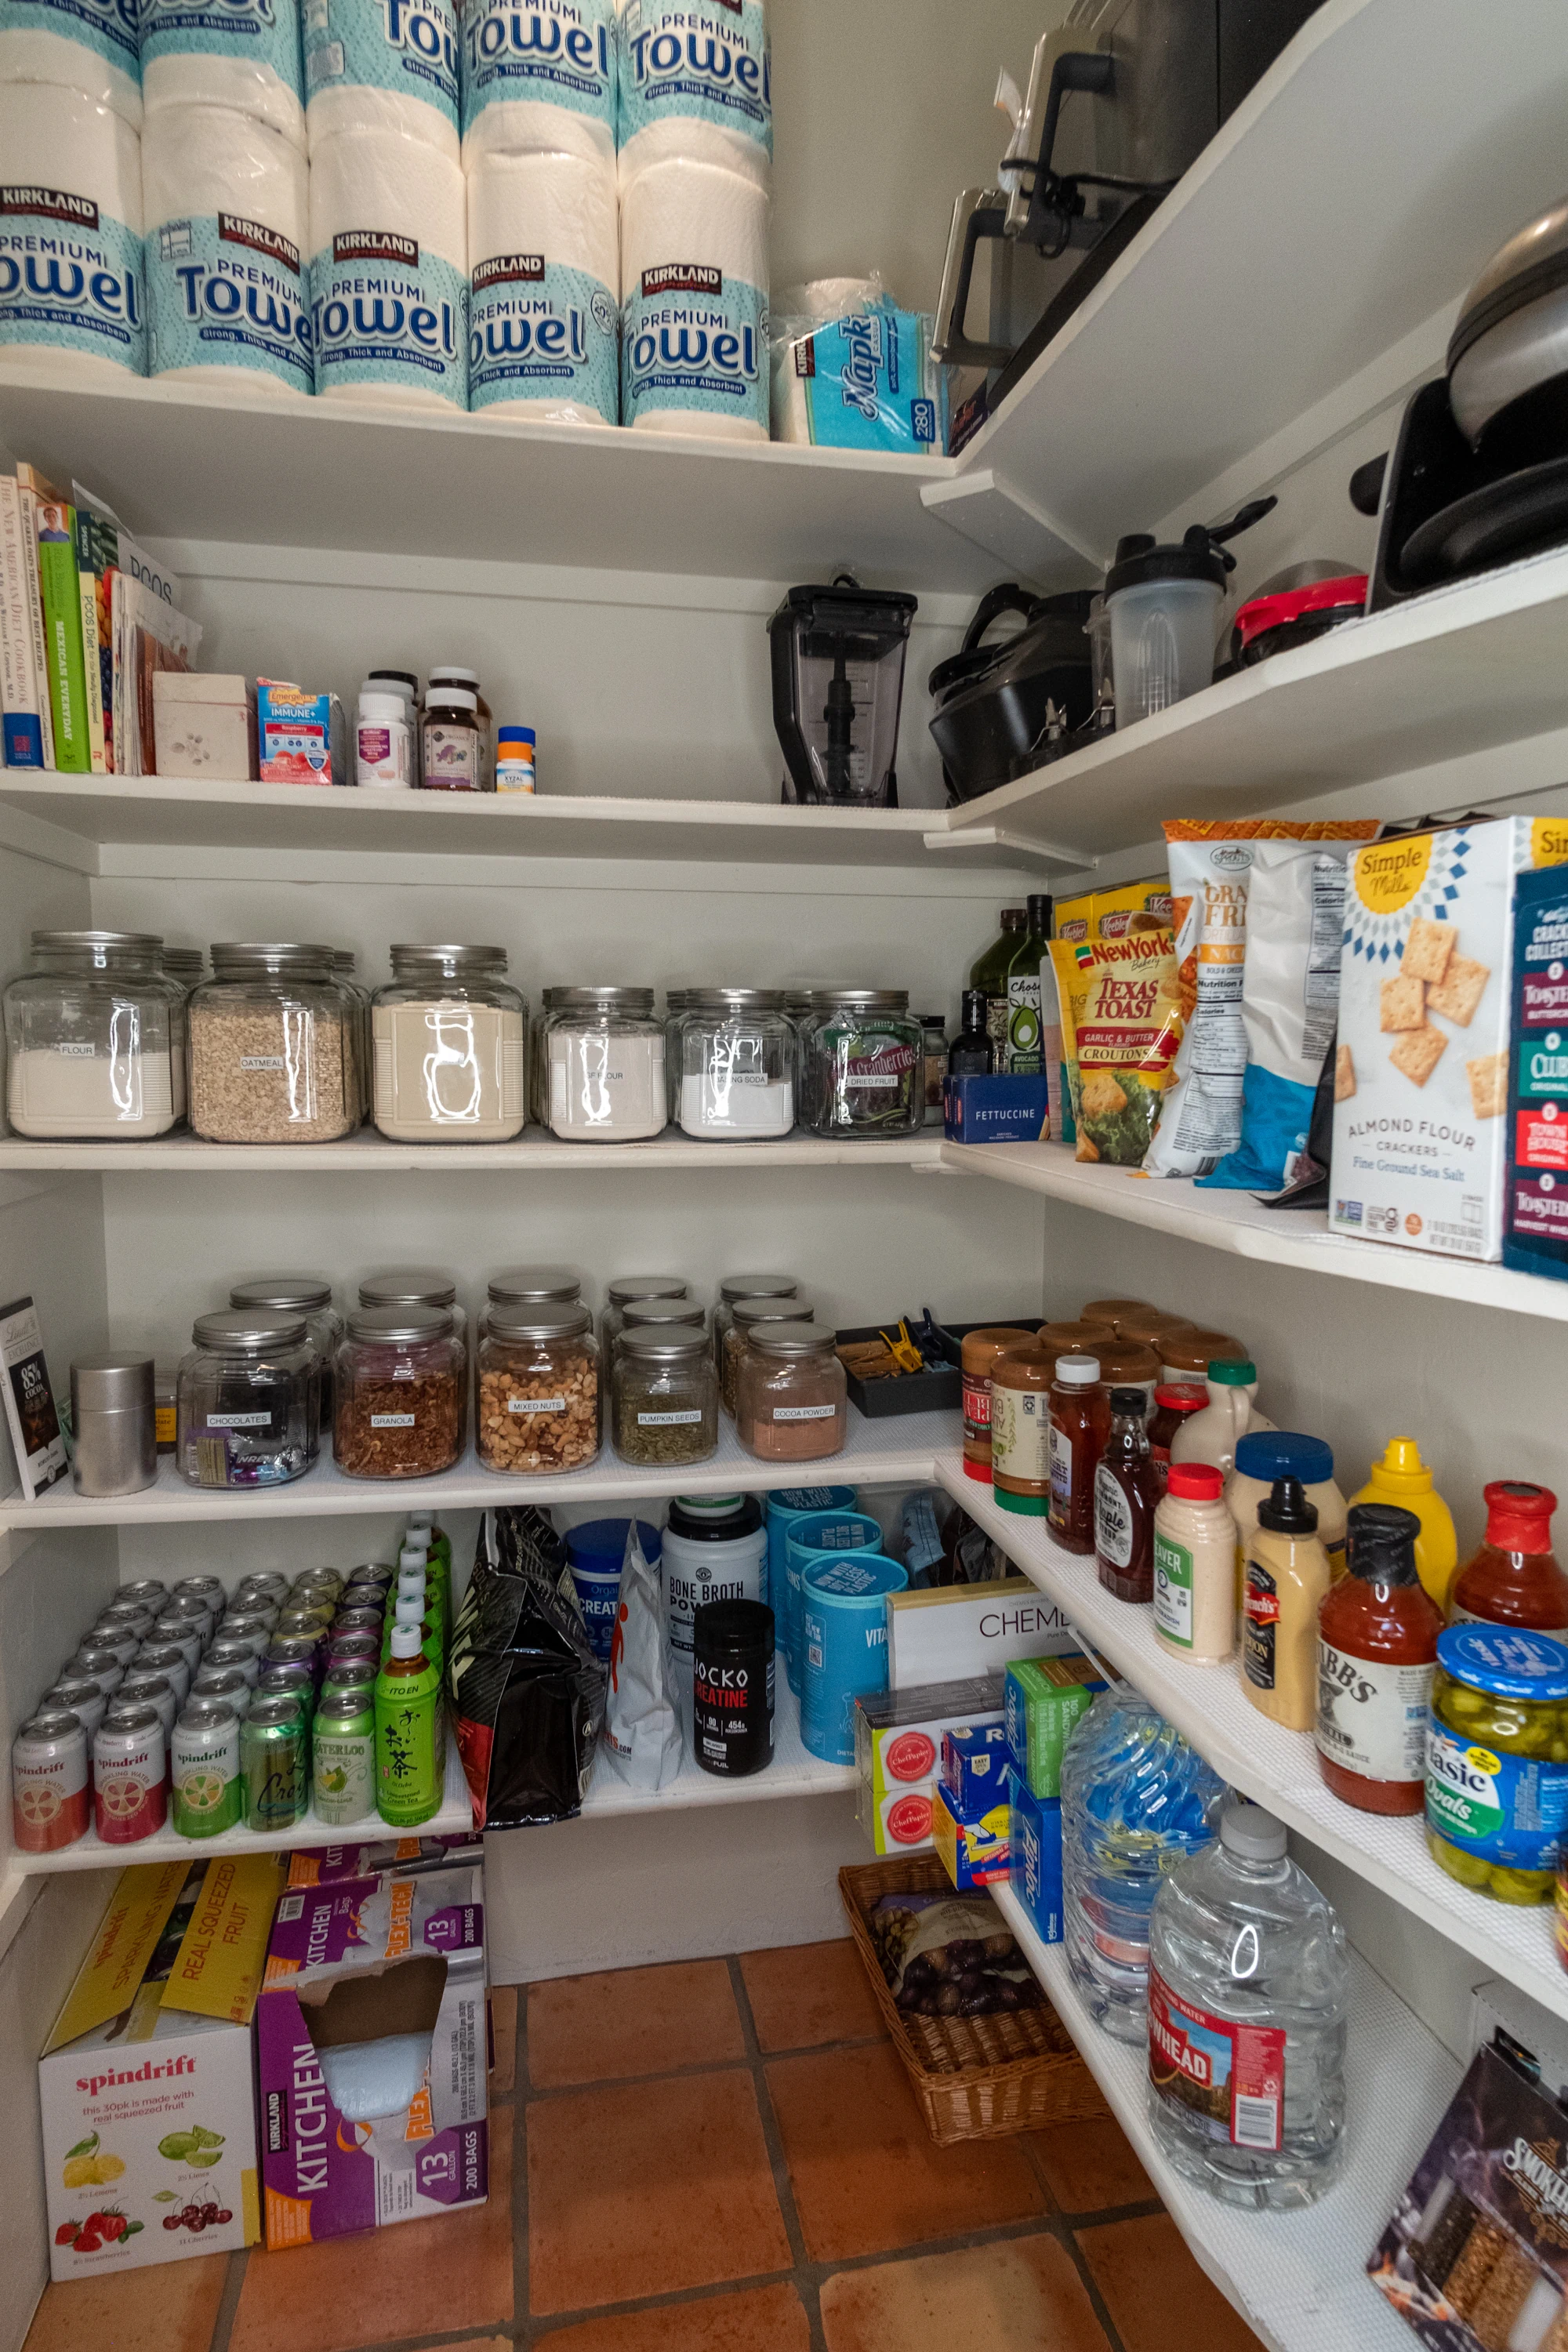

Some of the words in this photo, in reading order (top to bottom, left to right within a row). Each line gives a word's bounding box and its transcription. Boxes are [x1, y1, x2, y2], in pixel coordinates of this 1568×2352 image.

[204, 14, 257, 32] Absorbent
[662, 15, 745, 47] PREMIUM
[504, 66, 529, 76] Thick
[532, 66, 550, 78] and
[553, 71, 599, 94] Absorbent
[631, 31, 771, 107] Towel
[681, 85, 704, 95] Thick
[707, 88, 723, 102] and
[724, 96, 764, 121] Absorbent
[3, 188, 95, 218] KIRKLAND
[223, 216, 298, 262] KIRKLAND
[336, 233, 416, 255] KIRKLAND
[473, 256, 542, 284] KIRKLAND
[644, 265, 719, 286] KIRKLAND
[217, 259, 301, 308] PREMIUM
[332, 278, 420, 301] PREMIUM
[21, 307, 48, 318] Thick
[52, 311, 72, 321] and
[76, 316, 128, 341] Absorbent
[311, 296, 455, 356] Towel
[641, 309, 723, 330] PREMIUM
[241, 332, 267, 348] Thick
[270, 345, 287, 358] and
[348, 347, 372, 358] Thick
[397, 348, 442, 372] Absorbent
[483, 369, 501, 380] Thick
[504, 365, 521, 376] and
[523, 366, 571, 376] Absorbent
[653, 376, 676, 386] Thick
[680, 376, 696, 385] and
[699, 376, 743, 393] Absorbent
[914, 403, 929, 437] 280
[6, 539, 20, 602] AMERICAN
[129, 554, 172, 606] PCOS
[11, 604, 24, 634] DIET
[84, 595, 94, 627] PCOS
[56, 620, 67, 675] MEXICAN
[85, 628, 95, 648] Diet
[13, 637, 28, 705] COOKBOOK
[59, 678, 72, 742] EVERYDAY
[1360, 846, 1423, 876] Simple
[1062, 926, 1087, 939] Keebler
[1131, 957, 1161, 971] Bakery
[1098, 977, 1159, 1000] TEXAS
[1197, 980, 1238, 989] Nutrition
[1094, 999, 1157, 1019] TOAST
[1085, 1033, 1114, 1043] GARLIC
[1116, 1033, 1123, 1043] &
[1125, 1033, 1155, 1042] BUTTER
[61, 1046, 93, 1055] FLOUR
[1084, 1048, 1149, 1060] CROUTONS
[241, 1058, 283, 1069] OATMEAL
[851, 1077, 874, 1086] DRIED
[875, 1077, 896, 1086] FRUIT
[975, 1109, 1035, 1121] FETTUCCINE
[1348, 1118, 1414, 1138] ALMOND
[1418, 1120, 1476, 1152] FLOUR
[1528, 1122, 1567, 1139] TOWN
[1376, 1141, 1439, 1158] CRACKERS
[1527, 1137, 1568, 1155] HOUSE
[1352, 1156, 1374, 1170] Fine
[1377, 1160, 1418, 1175] Ground
[1420, 1165, 1440, 1178] Sea
[1443, 1167, 1465, 1182] Salt
[21, 1360, 42, 1390] 85%
[25, 1385, 45, 1399] COCOA
[514, 1402, 534, 1411] MIXED
[535, 1401, 561, 1410] NUTS
[774, 1409, 798, 1418] COCOA
[799, 1406, 835, 1417] POWDER
[209, 1416, 267, 1425] CHOCOLATES
[372, 1416, 412, 1426] GRANOLA
[639, 1414, 673, 1424] PUMPKIN
[673, 1413, 700, 1422] SEEDS
[793, 1498, 834, 1509] PLASTIC
[812, 1573, 837, 1587] NOW
[827, 1561, 854, 1579] WITH
[843, 1566, 867, 1581] LESS
[843, 1573, 877, 1595] PLASTIC
[670, 1575, 697, 1600] BONE
[702, 1580, 744, 1602] BROTH
[694, 1657, 749, 1688] JOCKO
[390, 1686, 407, 1696] ITO
[407, 1686, 419, 1695] EN
[1069, 1697, 1080, 1717] 100
[708, 1716, 717, 1726] 90
[98, 1751, 150, 1770] spindrift
[177, 1745, 229, 1765] spindrift
[892, 1748, 931, 1766] ChefPapier
[16, 1761, 66, 1777] spindrift
[130, 1769, 151, 1785] WATER
[210, 1765, 229, 1779] WATER
[1427, 1773, 1472, 1820] Ovals
[892, 1811, 931, 1829] ChefPapier
[1022, 1834, 1036, 1909] Ziploc
[338, 1896, 353, 1915] Bags
[464, 1907, 474, 1926] BAGS
[182, 1940, 212, 1981] REAL
[198, 1863, 236, 1937] SQUEEZED
[223, 1902, 249, 1945] FRUIT
[383, 1882, 416, 1958] FLEX-TECH
[428, 1919, 449, 1940] 13
[305, 1904, 332, 1969] KITCHEN
[464, 1926, 474, 1943] 200
[1179, 2002, 1206, 2024] WATER
[76, 2054, 196, 2097] spindrift
[83, 2106, 100, 2115] this
[103, 2102, 129, 2113] 30pk
[132, 2099, 140, 2107] is
[142, 2094, 170, 2106] made
[172, 2090, 194, 2100] with
[93, 2112, 113, 2123] real
[114, 2105, 162, 2120] squeezed
[164, 2101, 185, 2111] fruit
[268, 2092, 281, 2152] KIRKLAND
[292, 2042, 328, 2193] KITCHEN
[465, 2130, 477, 2160] BAGS
[188, 2171, 210, 2180] Limes
[421, 2151, 449, 2187] 13
[448, 2150, 456, 2181] GALLON
[466, 2160, 477, 2190] 200
[187, 2233, 219, 2243] Cherries
[84, 2249, 131, 2264] Strawberries
